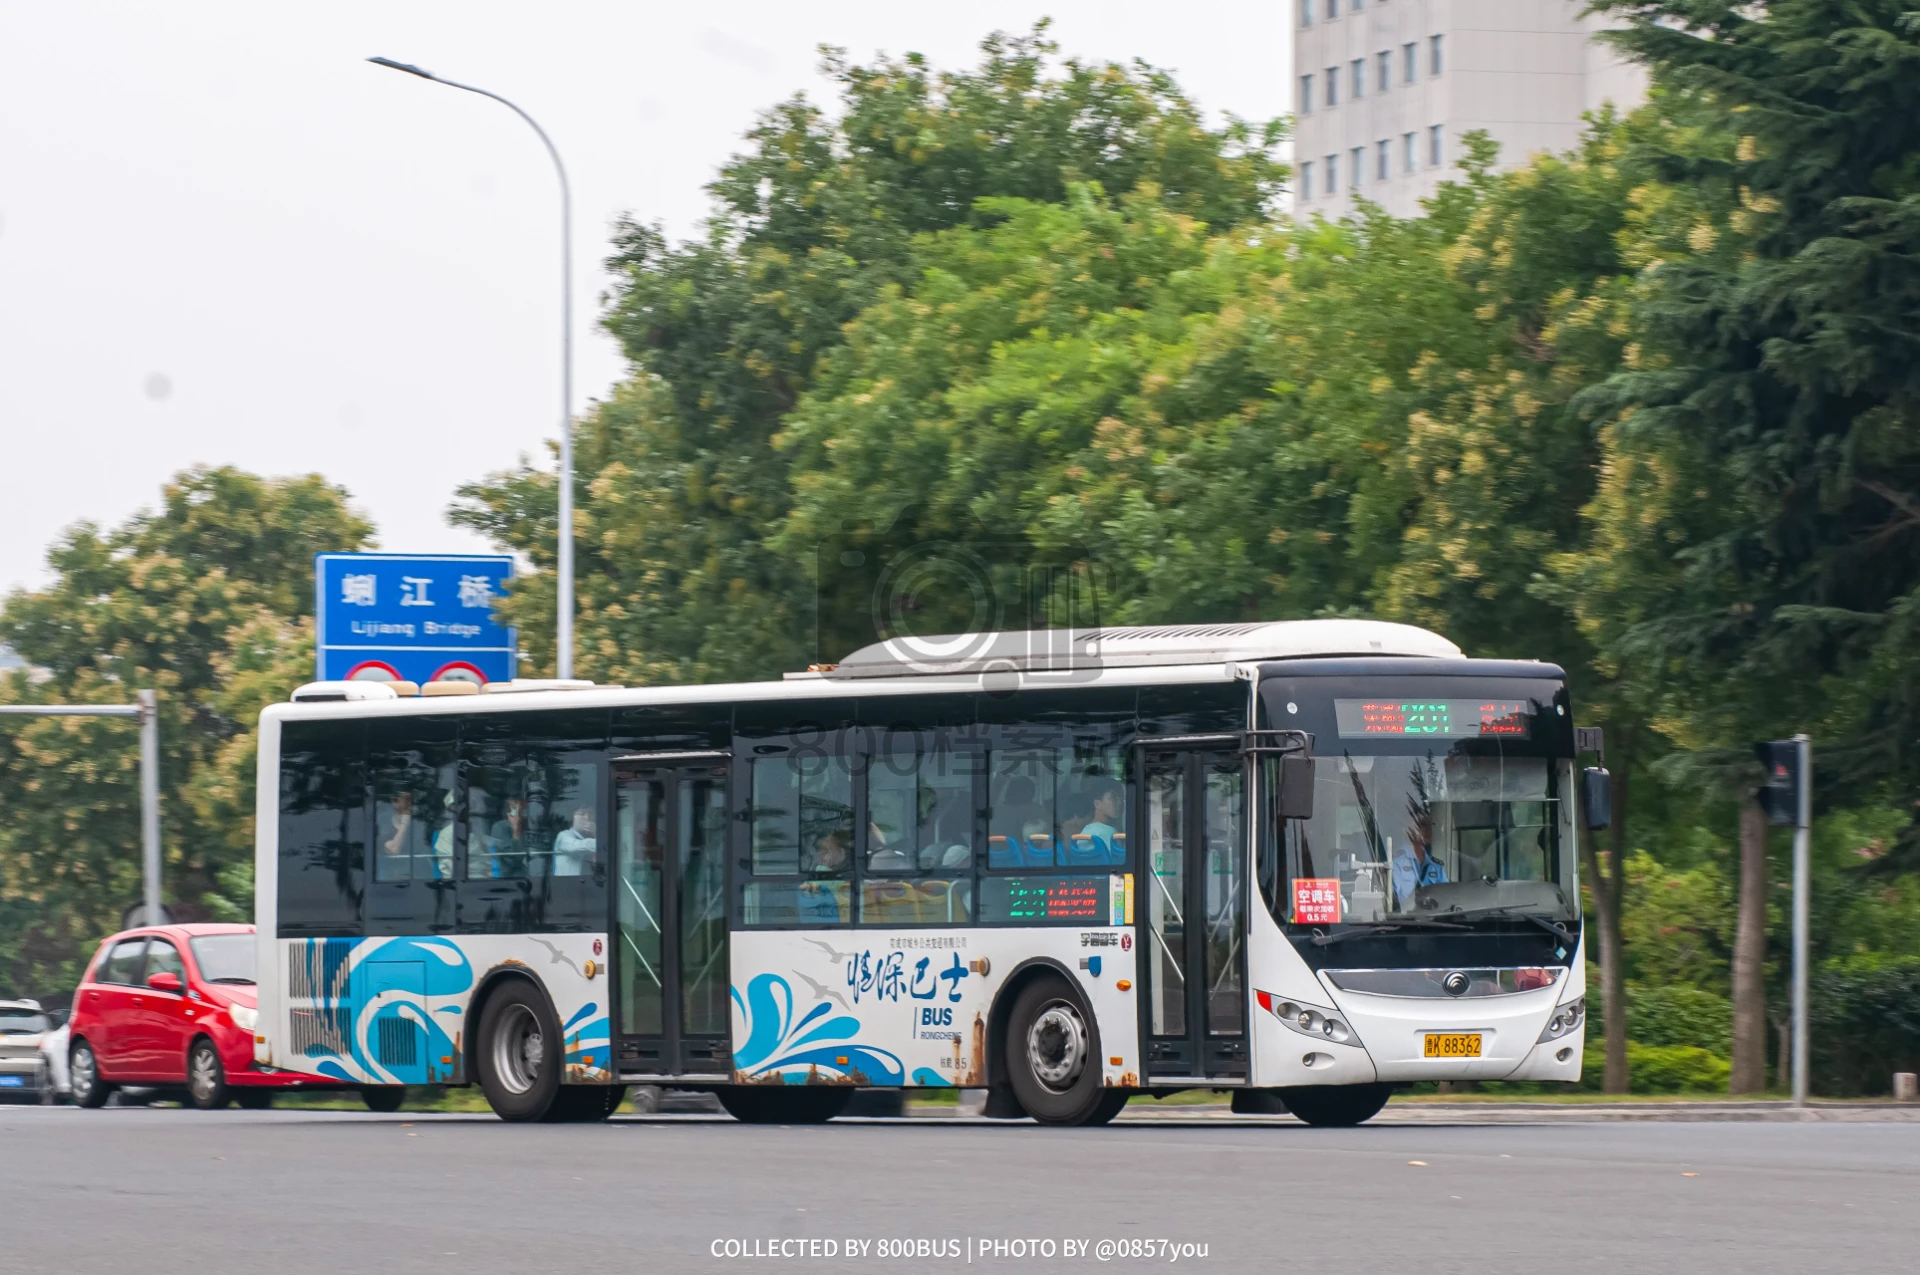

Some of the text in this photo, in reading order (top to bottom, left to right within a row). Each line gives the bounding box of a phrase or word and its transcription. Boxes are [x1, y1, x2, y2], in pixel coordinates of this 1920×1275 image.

[351, 620, 482, 639] Lijiang Bridge
[1298, 889, 1335, 904] 空调车
[1080, 932, 1118, 947] 宇通客车
[921, 1007, 953, 1026] BUS
[920, 1031, 962, 1040] RONGCHENG
